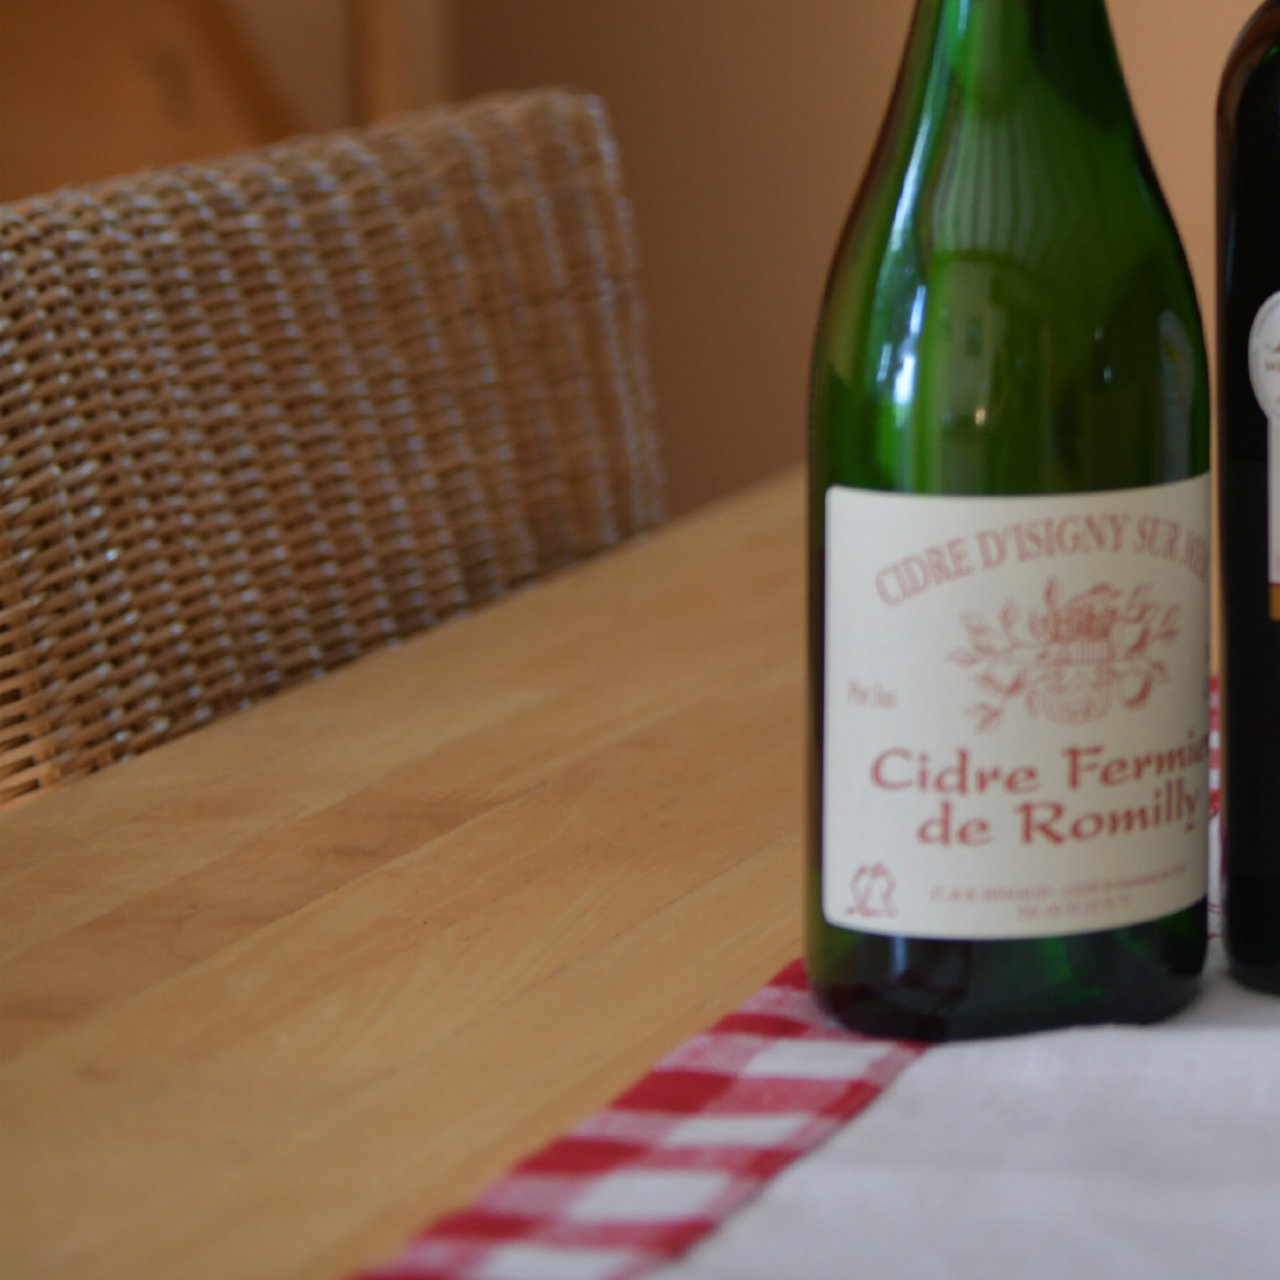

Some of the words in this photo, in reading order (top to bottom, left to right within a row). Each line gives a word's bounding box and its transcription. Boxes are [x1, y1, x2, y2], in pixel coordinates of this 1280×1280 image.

[874, 536, 976, 608] CIDRE
[976, 512, 1131, 570] D'ISIGNY
[870, 746, 1038, 797] Cidre
[1060, 727, 1209, 789] Fermie
[916, 800, 995, 848] de
[1015, 777, 1201, 846] Romilly
